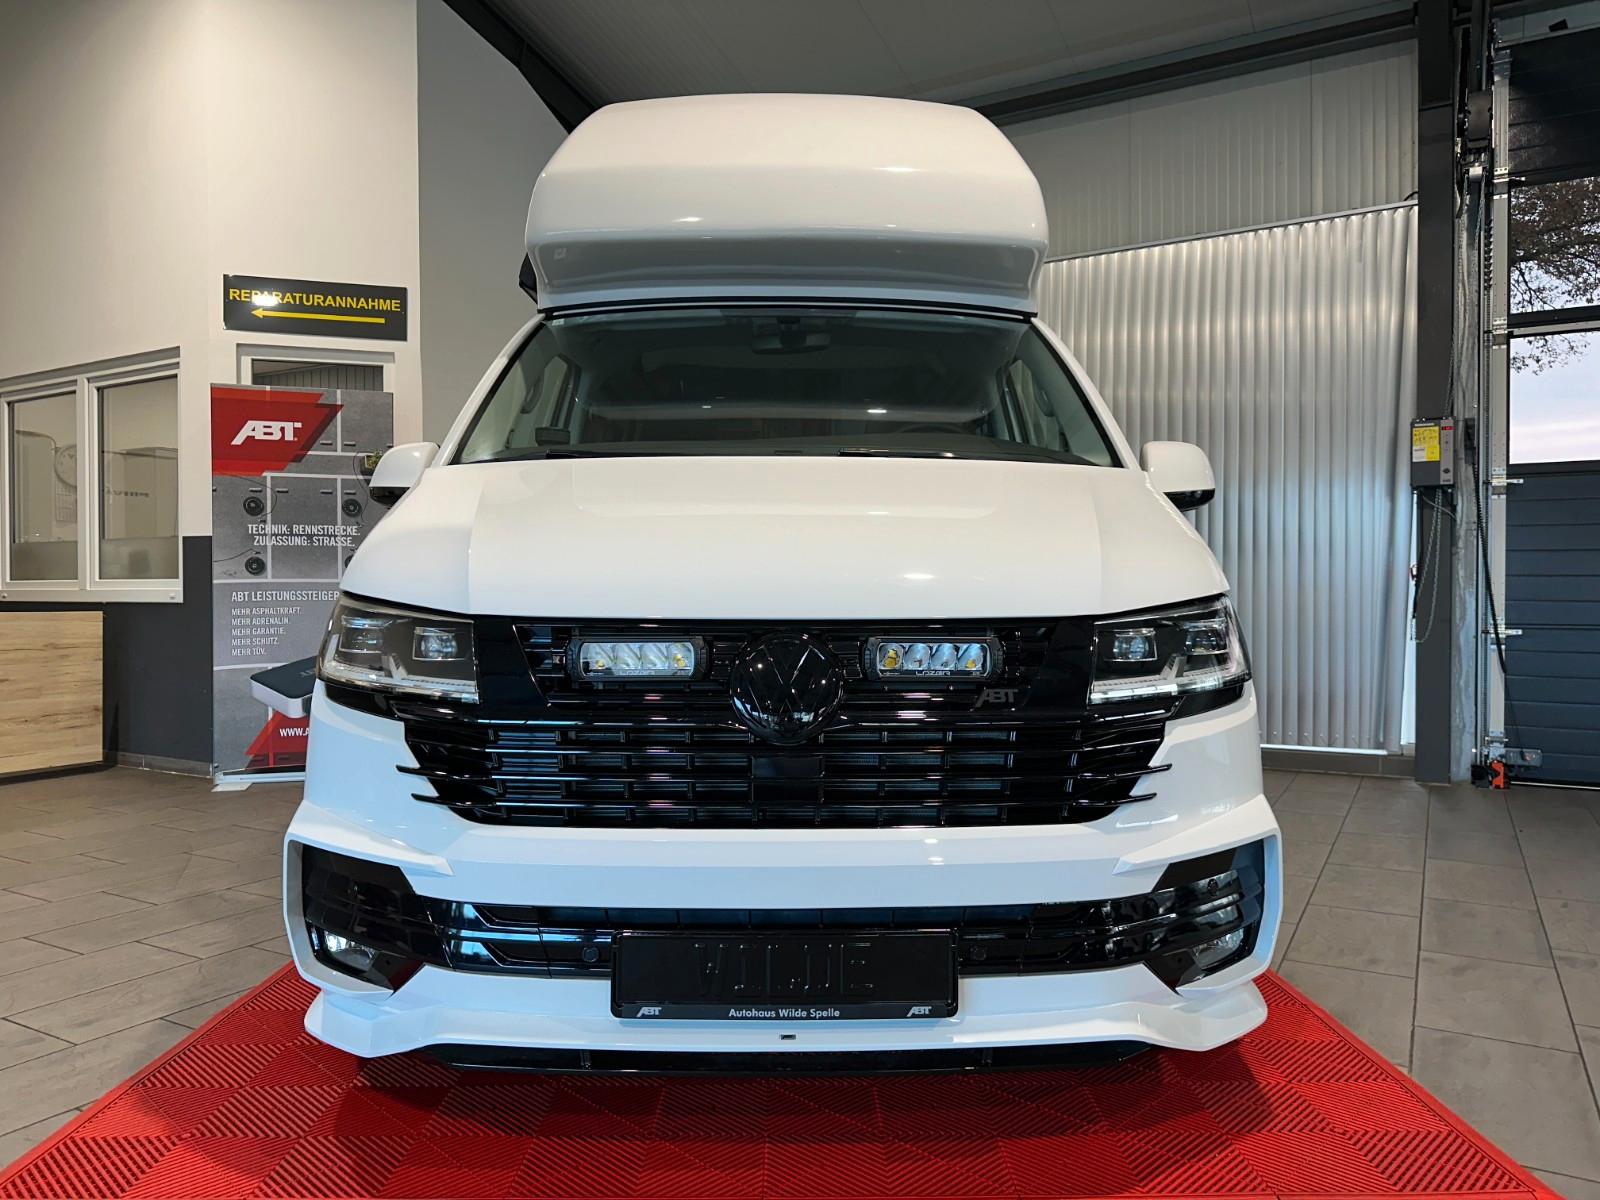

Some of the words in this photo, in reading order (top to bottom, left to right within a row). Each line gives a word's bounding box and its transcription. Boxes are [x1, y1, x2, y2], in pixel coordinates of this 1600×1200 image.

[230, 419, 303, 446] ABT
[247, 523, 291, 535] TECHNIK:
[292, 524, 361, 536] RENNSTRECKE.
[253, 535, 311, 546] ZULASSUNG:
[312, 536, 356, 547] STRASSE.
[231, 591, 249, 602] ABT
[231, 608, 251, 616] MEHR
[974, 688, 1019, 708] ABT
[636, 1006, 662, 1018] ABT
[728, 1008, 776, 1018] Autohaus
[778, 1008, 808, 1018] Wilde
[809, 1008, 841, 1020] Spelle
